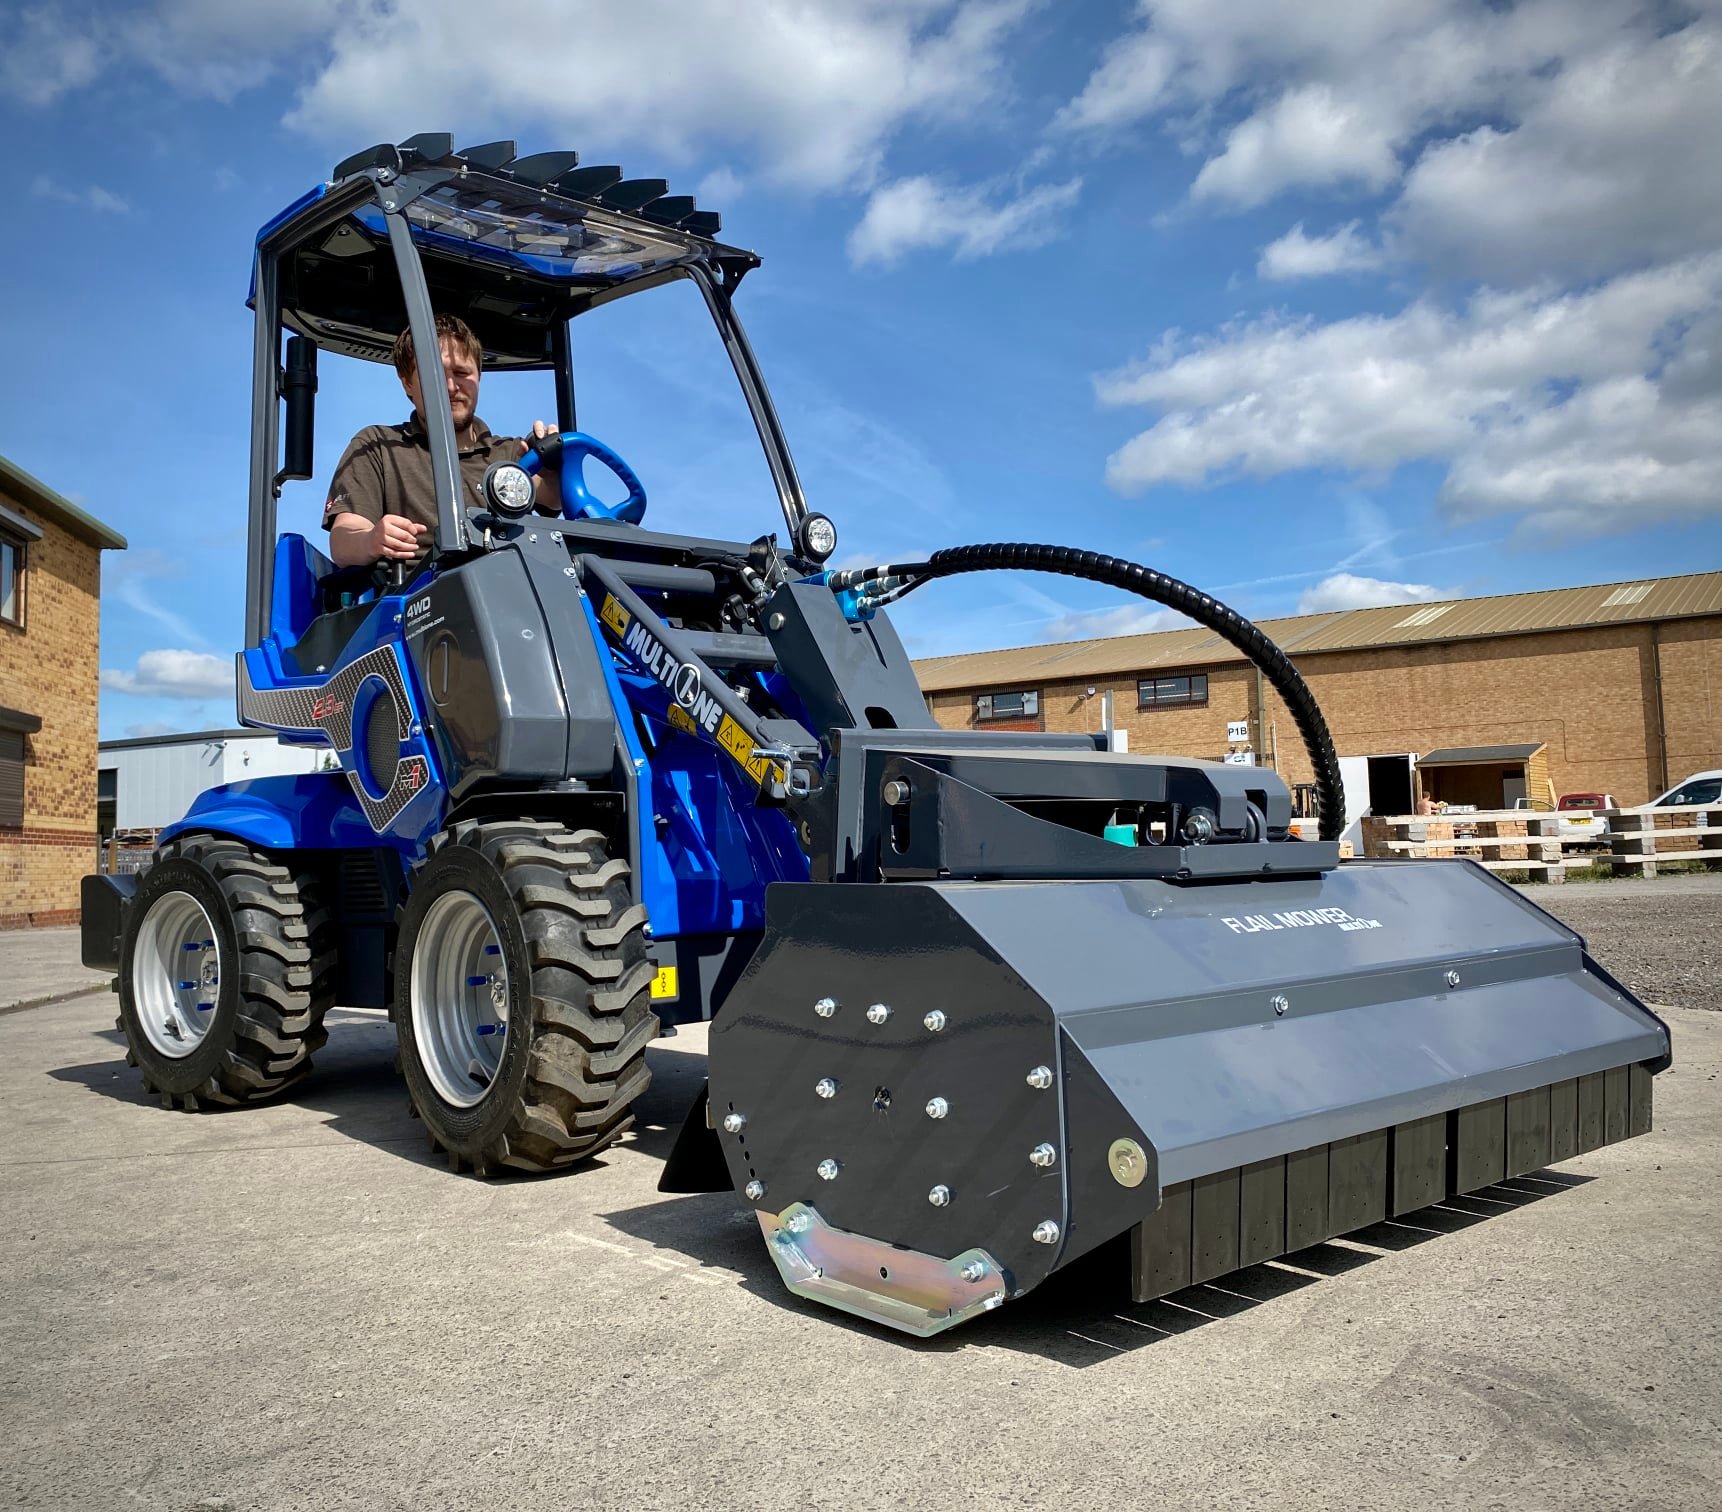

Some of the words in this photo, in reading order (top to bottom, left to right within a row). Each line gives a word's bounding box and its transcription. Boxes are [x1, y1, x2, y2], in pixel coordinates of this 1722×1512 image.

[407, 596, 431, 618] 4WD
[1228, 726, 1247, 736] P1B
[1220, 914, 1284, 934] FLAIL
[1272, 907, 1354, 929] MOWER
